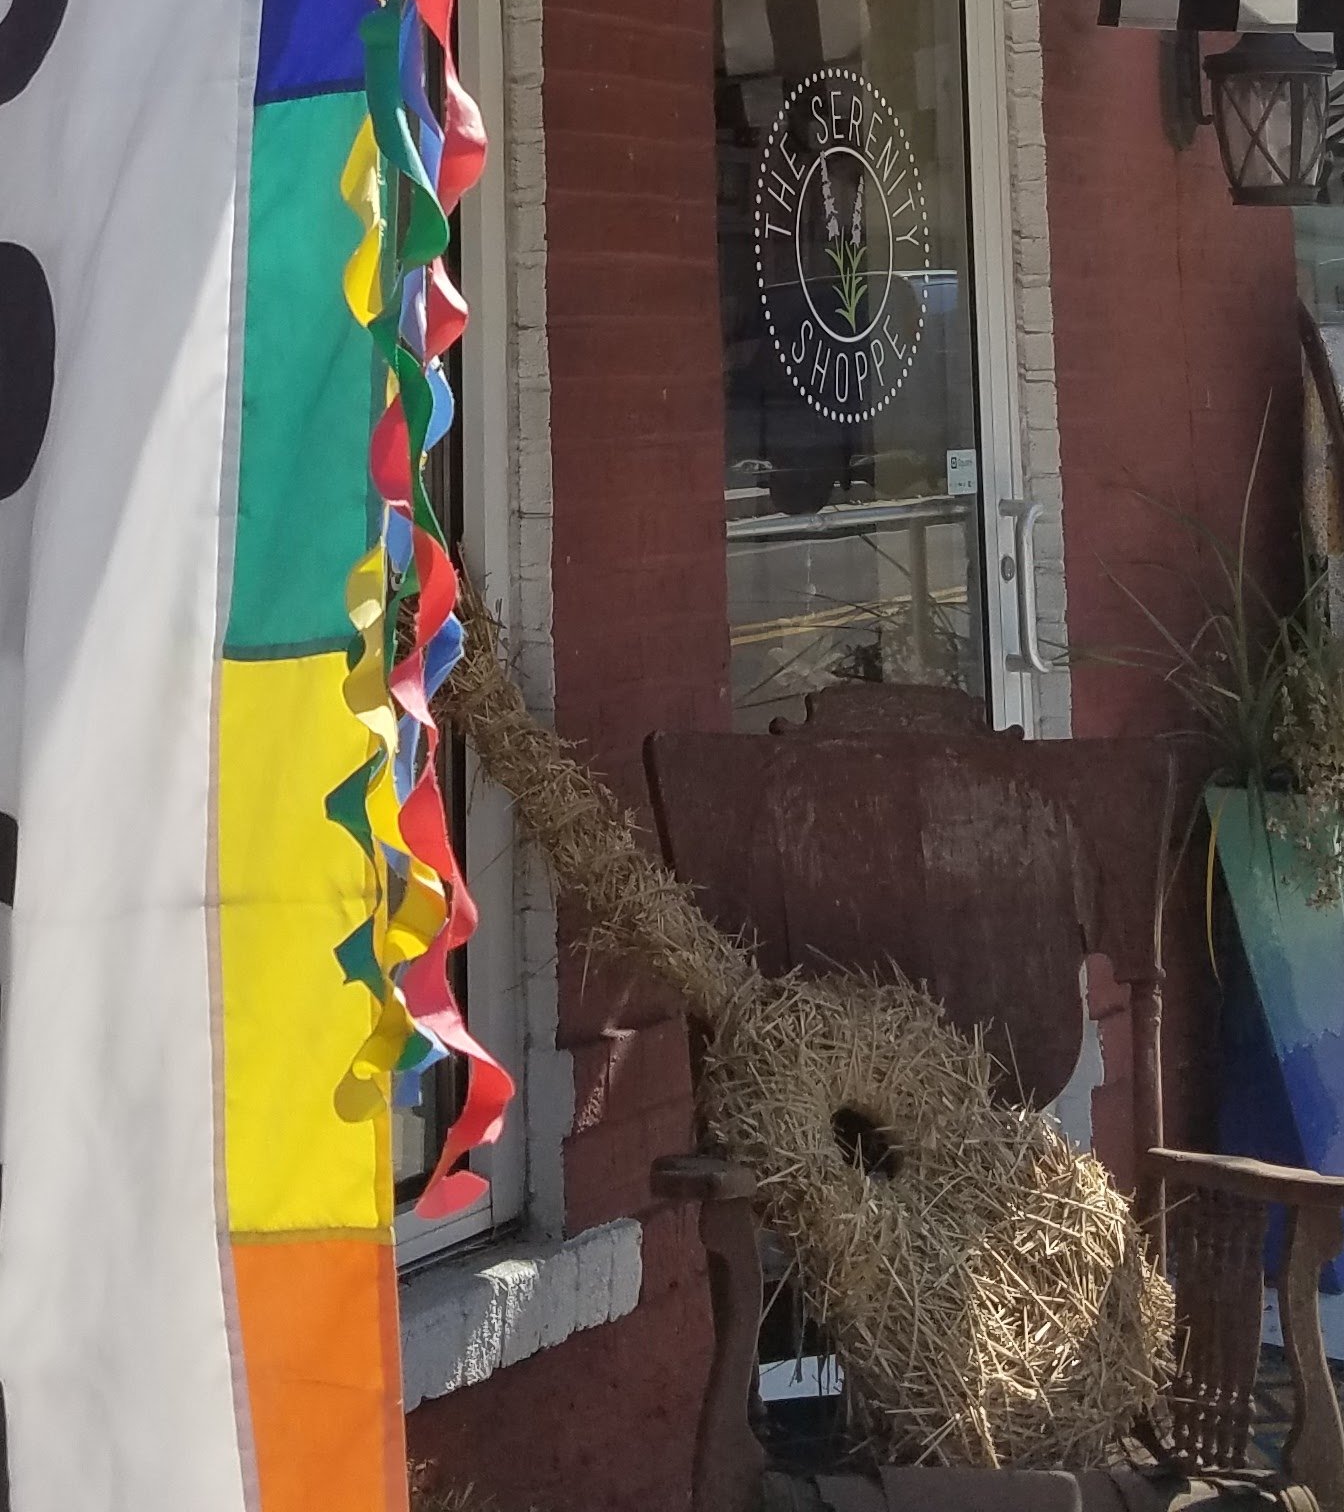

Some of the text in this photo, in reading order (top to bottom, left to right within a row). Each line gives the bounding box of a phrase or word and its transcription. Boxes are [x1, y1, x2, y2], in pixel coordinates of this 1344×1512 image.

[764, 90, 920, 247] THE SERENITY
[791, 314, 907, 403] SHOPPE
